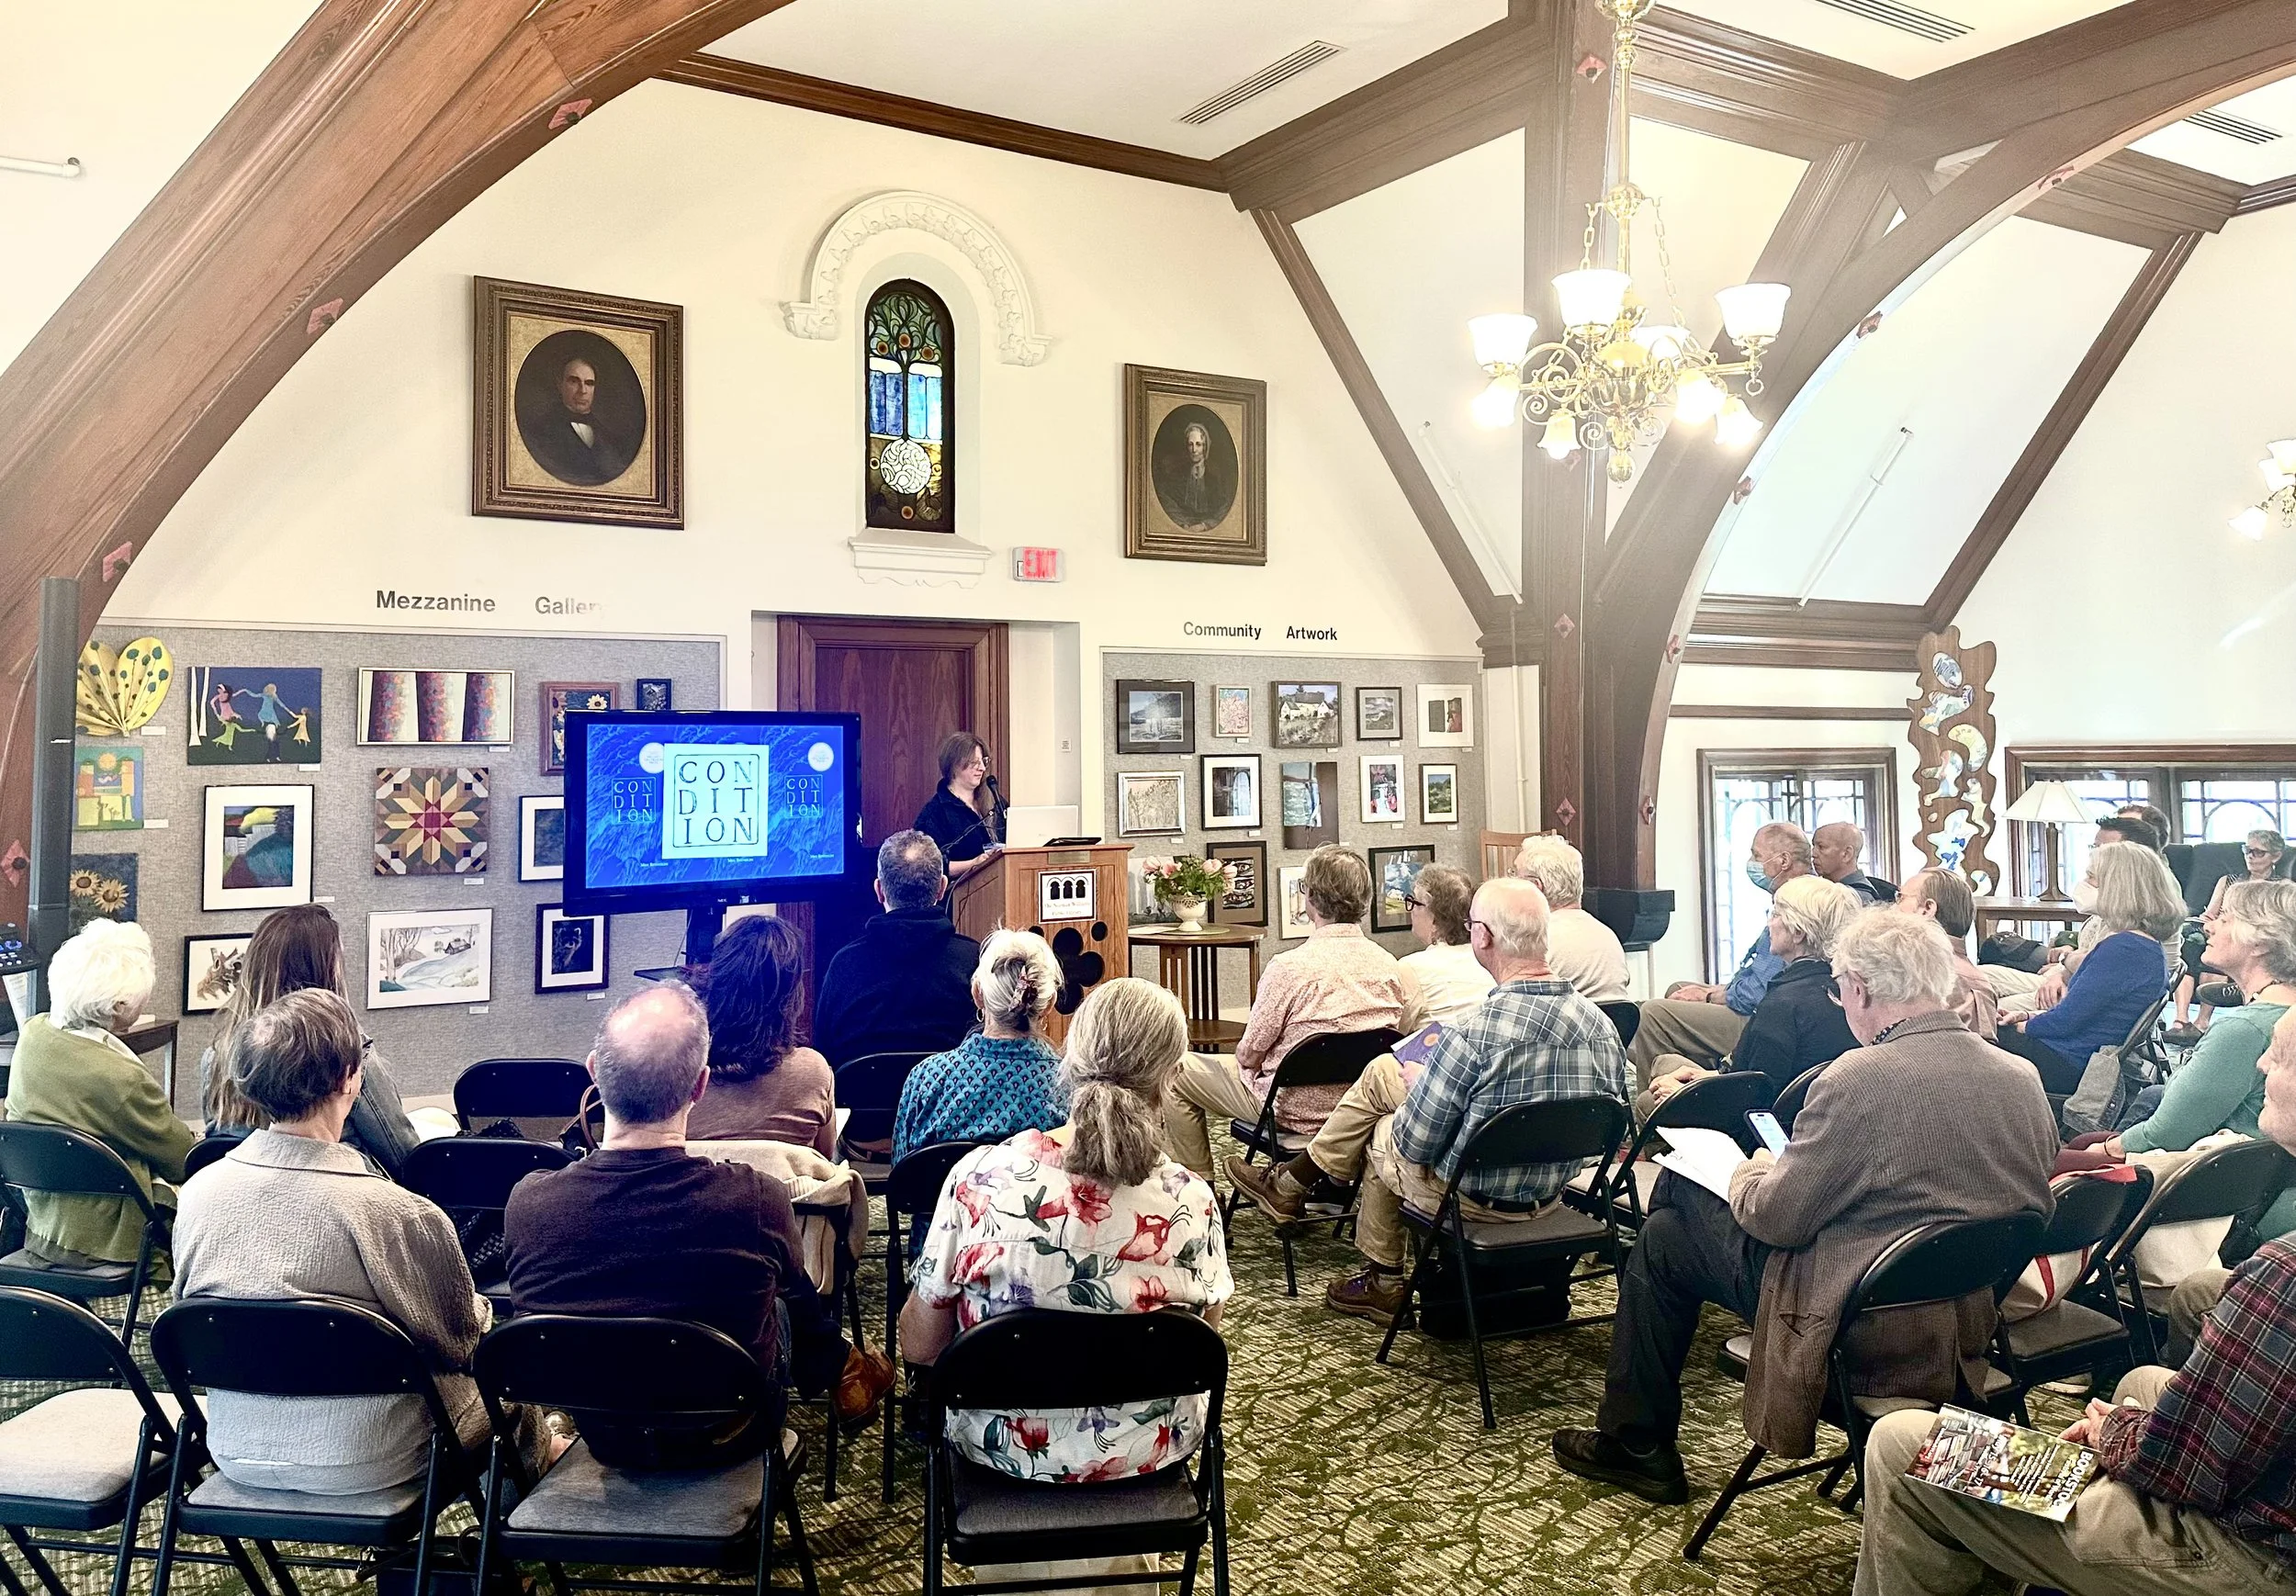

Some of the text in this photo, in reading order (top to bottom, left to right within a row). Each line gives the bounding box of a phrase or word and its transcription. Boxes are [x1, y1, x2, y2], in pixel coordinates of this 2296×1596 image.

[376, 590, 605, 619] Mezzanine Galler
[1183, 622, 1338, 641] Community Artwork
[2053, 1450, 2094, 1508] BOOKSTOC
